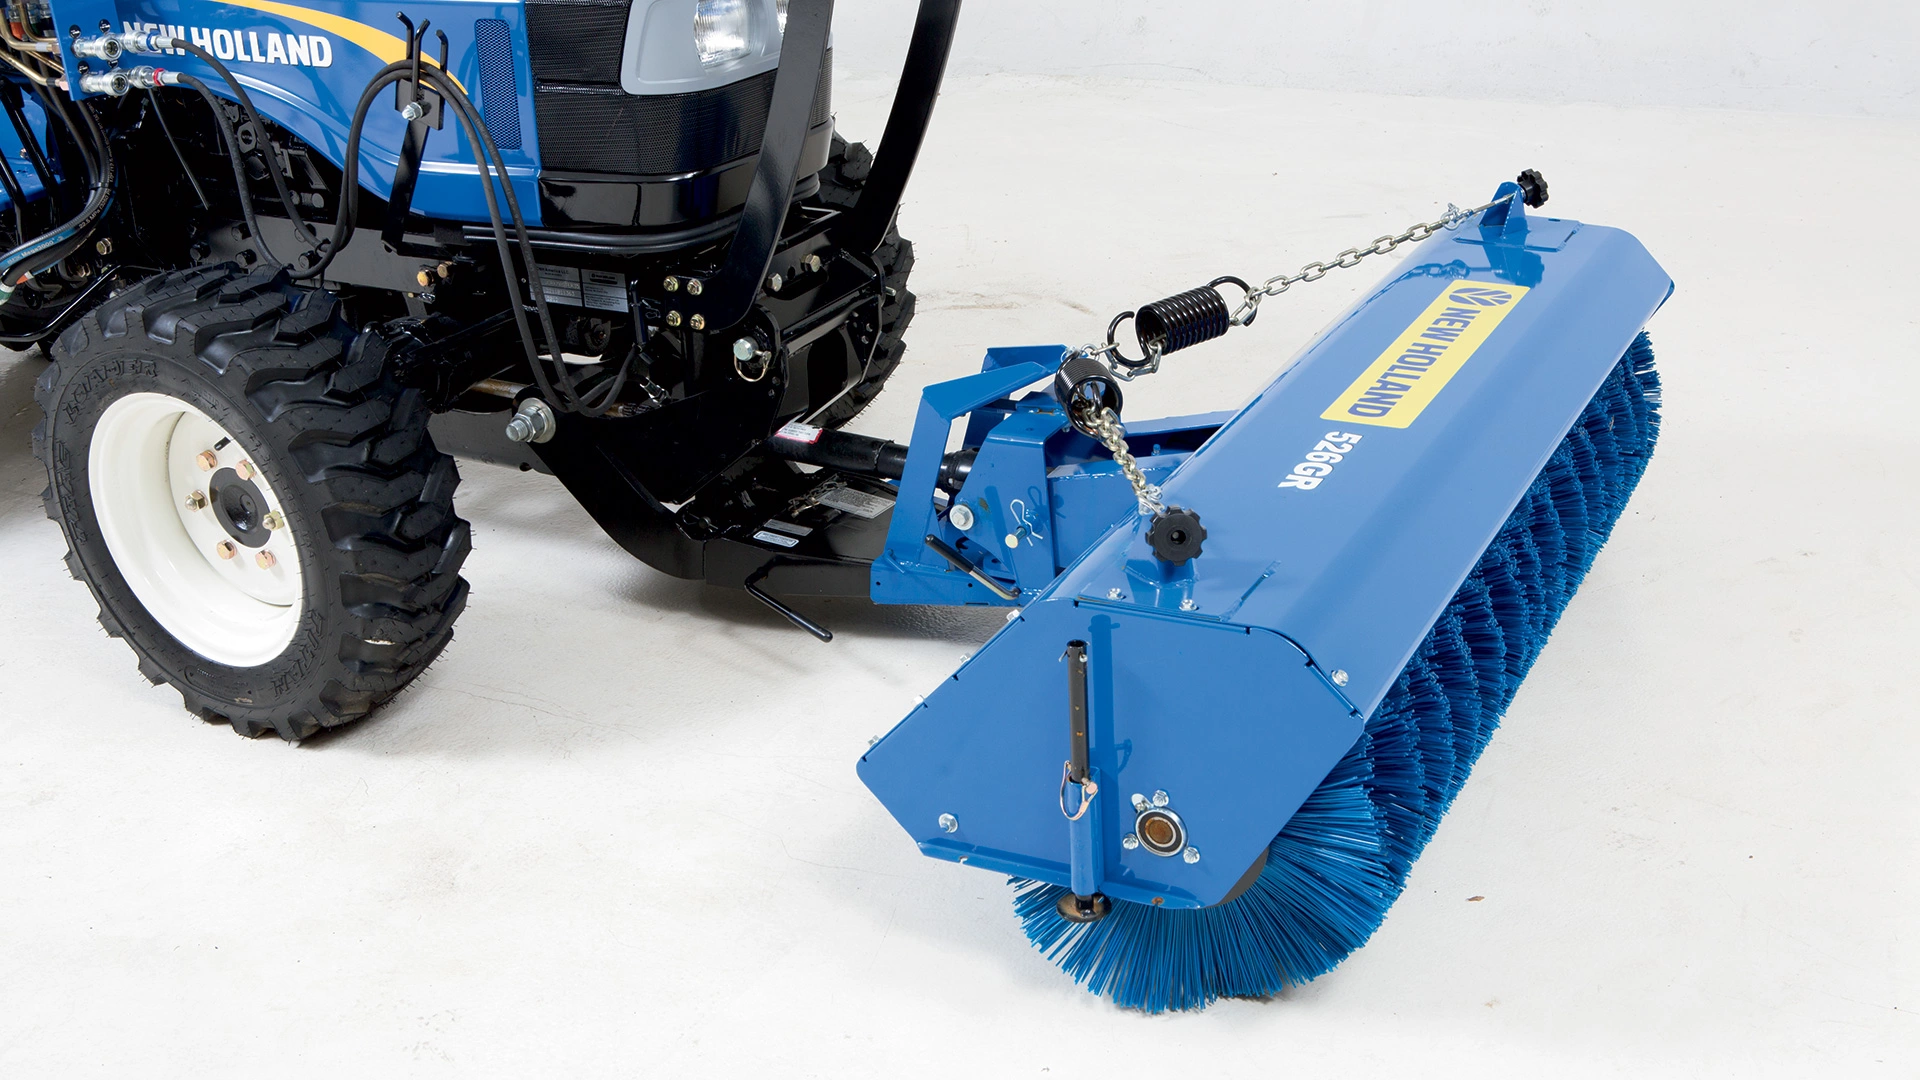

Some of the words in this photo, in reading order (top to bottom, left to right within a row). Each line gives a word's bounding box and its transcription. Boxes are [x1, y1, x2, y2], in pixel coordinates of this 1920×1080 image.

[190, 26, 333, 68] HOLLAND
[1420, 307, 1481, 342] NEW
[1347, 342, 1449, 418] HOLLAND
[1277, 431, 1363, 491] 526GR
